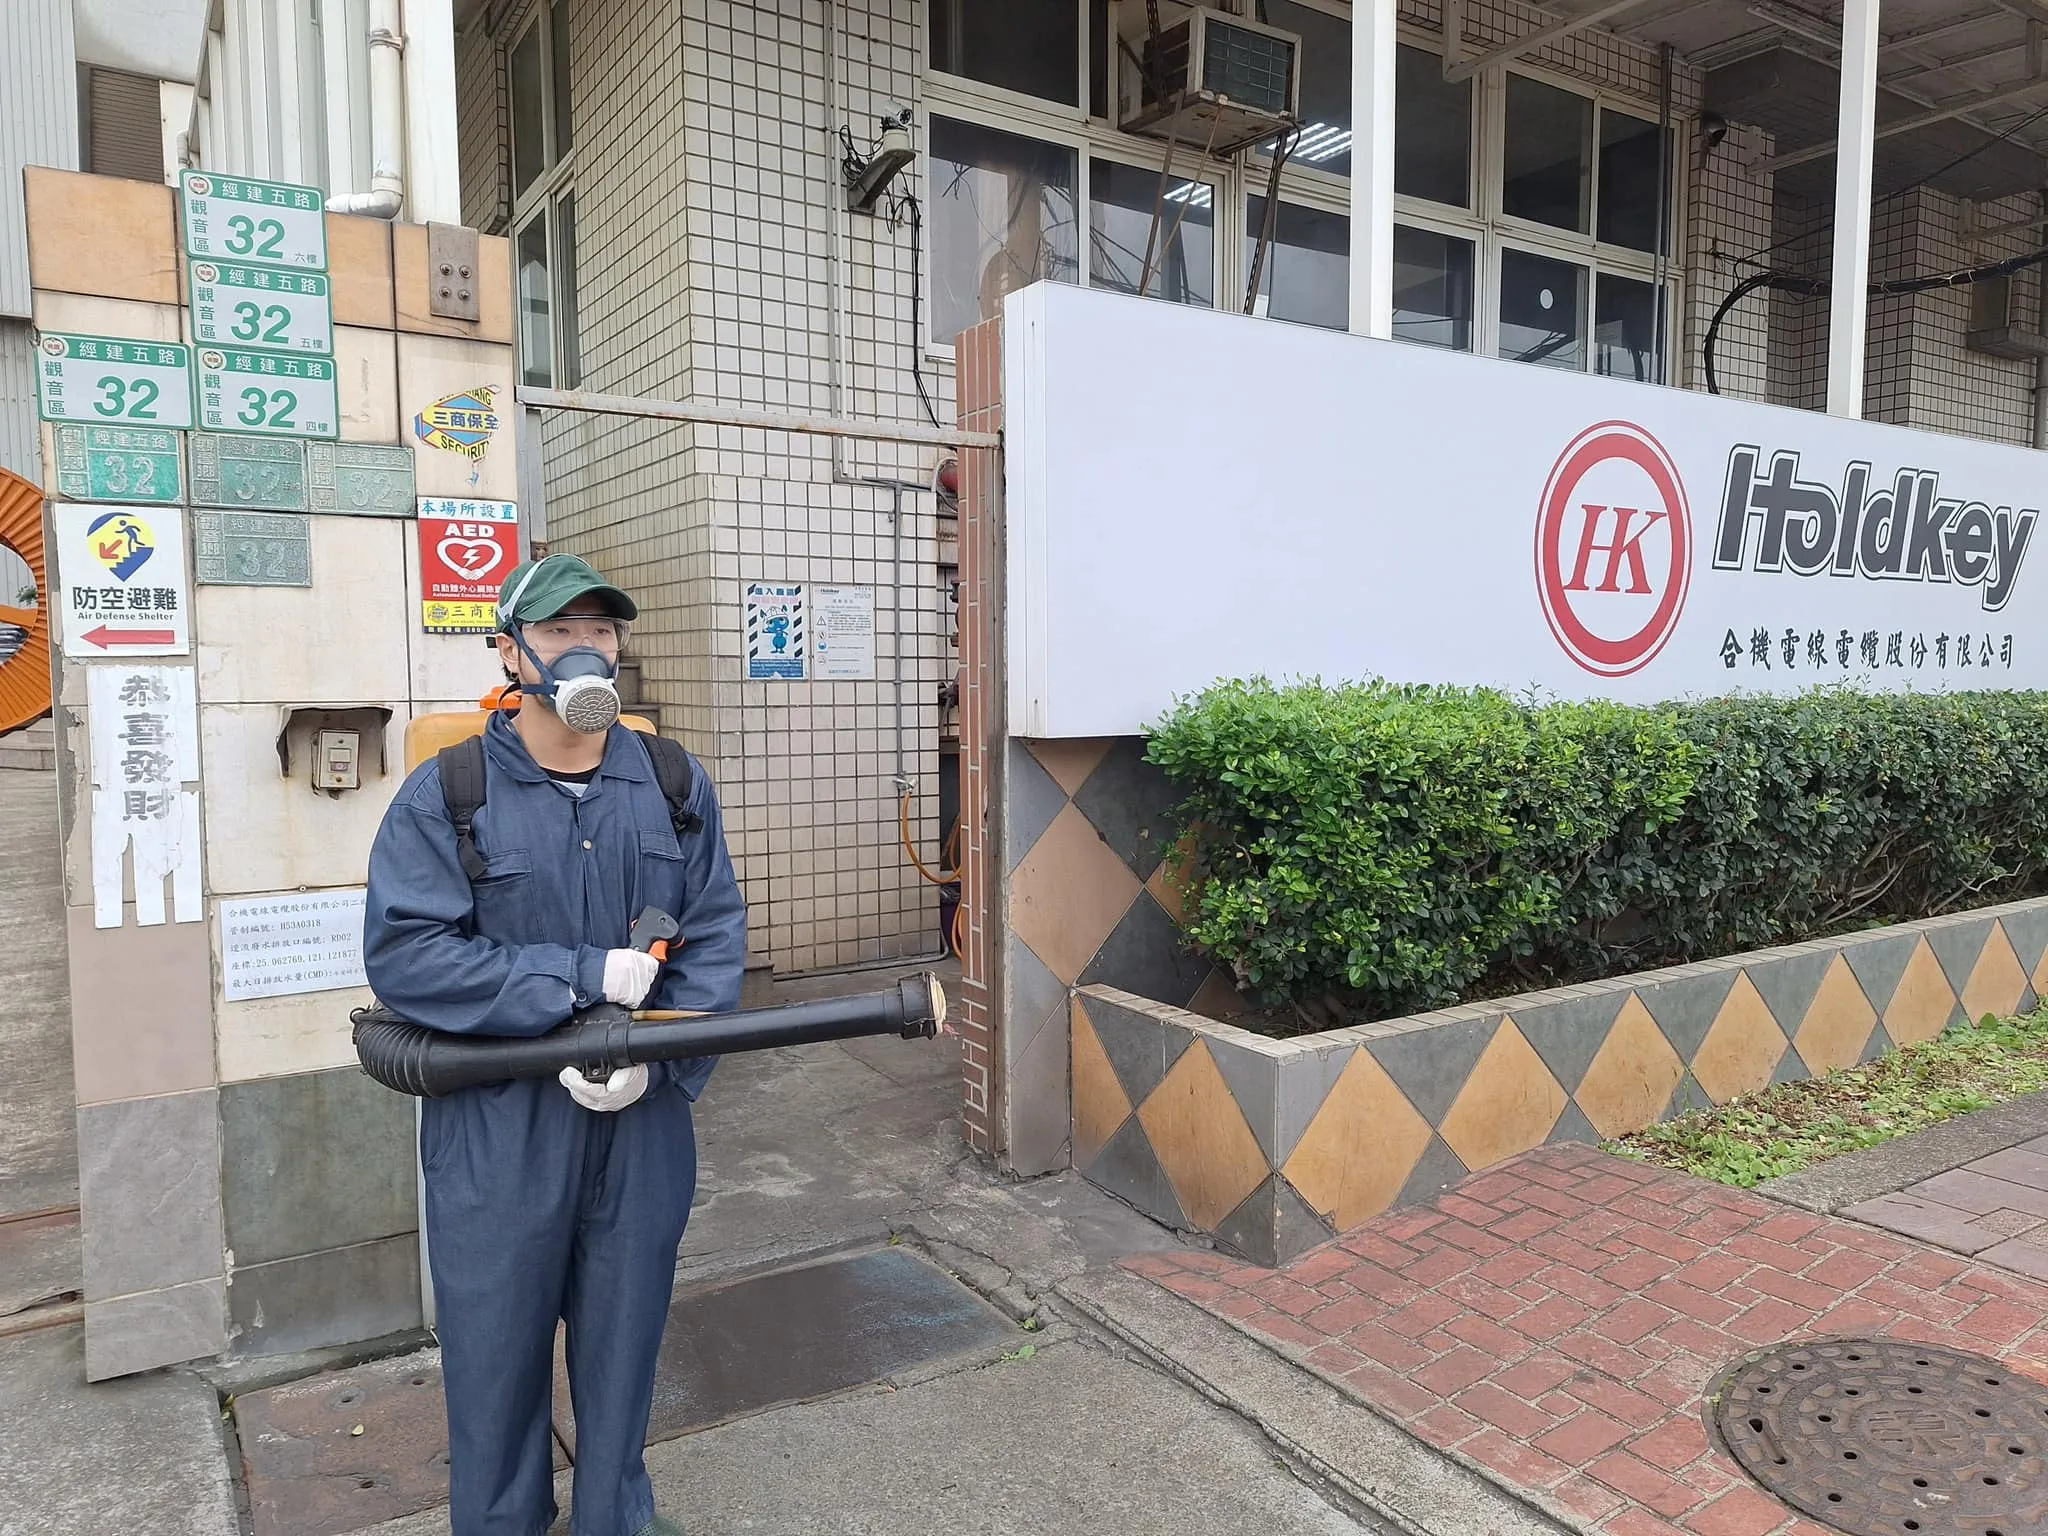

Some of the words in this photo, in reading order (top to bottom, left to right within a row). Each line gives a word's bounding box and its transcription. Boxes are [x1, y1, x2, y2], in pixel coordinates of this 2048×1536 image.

[221, 182, 310, 209] 經建五路
[190, 199, 209, 253] 觀音區
[224, 215, 286, 259] 32
[228, 268, 317, 293] 經建五路
[197, 286, 216, 339] 觀音區
[231, 301, 292, 344] 32
[79, 341, 175, 365] 經建五路
[235, 355, 323, 378] 經建五路
[44, 360, 66, 416] 觀音區
[93, 375, 160, 419] 32
[204, 374, 223, 426] 觀音區
[237, 387, 298, 429] 32
[433, 411, 499, 430] 三商保全
[440, 435, 490, 460] SECURIT
[104, 455, 157, 495] 32
[235, 462, 281, 500] 32
[350, 471, 394, 508] 32
[421, 500, 515, 520] 本場所設置
[1712, 443, 2040, 612] Holdkey
[444, 523, 495, 538] AED
[1562, 503, 1668, 594] HK
[240, 541, 288, 578] 32
[72, 586, 178, 611] 防空避難
[78, 612, 92, 620] Air
[95, 612, 136, 620] Defense
[138, 612, 174, 621] Shelter
[1718, 627, 2014, 671] 合機電線電纜股份有限公司
[118, 674, 175, 822] 恭喜發財
[229, 900, 366, 918] 合機電線電纜股份有限公司二
